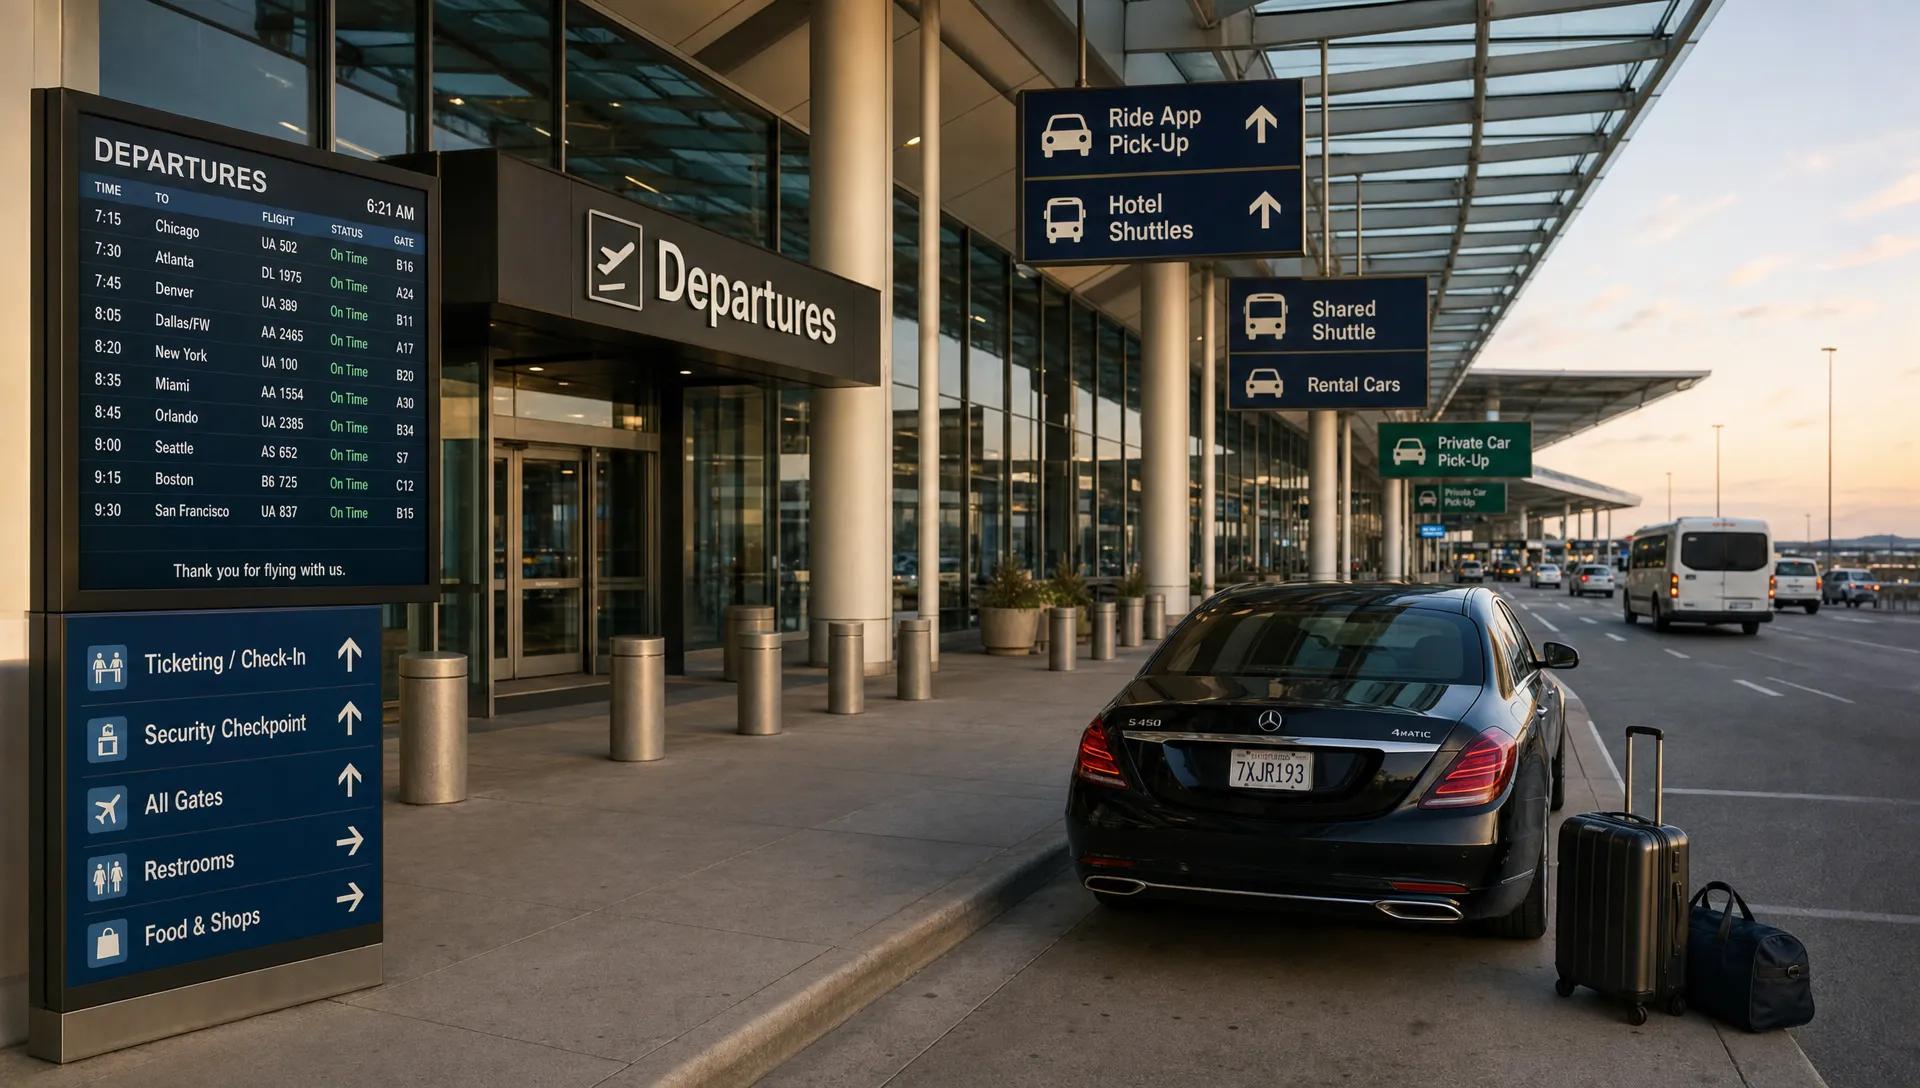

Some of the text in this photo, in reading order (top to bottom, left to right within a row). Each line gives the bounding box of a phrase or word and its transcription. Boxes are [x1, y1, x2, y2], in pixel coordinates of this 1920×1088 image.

[1110, 106, 1201, 129] Ride App
[1110, 133, 1188, 156] Pick-Up
[95, 137, 266, 193] DEPARTURES
[95, 182, 413, 247] TIME TO FLIGHT STATUS GATE
[367, 199, 414, 220] 6:21 AM
[1110, 193, 1161, 214] Hotel
[96, 209, 413, 272] 7:15 Chicago UA 502 On Time B16
[1110, 220, 1193, 241] Shuttles
[96, 242, 413, 299] 7:30 Atlanta DL 1975 On Time A24
[96, 274, 412, 326] 7:45 Denver UA 389 On Time B11
[657, 238, 837, 345] Departures
[1313, 300, 1375, 317] Shared
[95, 307, 413, 354] 8:05 Dallas/FW AA 2465 On Time A17
[1313, 323, 1375, 340] Shuttle
[95, 340, 413, 381] 8:20 New York UA 100 On Time B20
[95, 372, 413, 408] 8:35 Miami AA 1554 On Time A30
[1309, 377, 1400, 392] Rental Cars
[95, 405, 413, 436] 8:45 Orlando UA 2385 On Time B34
[95, 437, 408, 463] 9:00 Seattle AS 652 On Time S7
[1439, 436, 1511, 449] Private Car
[1439, 454, 1489, 470] Pick-Up
[95, 470, 413, 491] 9:15 Boston B6 725 On Time C12
[1445, 488, 1486, 496] Private Car
[95, 503, 413, 519] 9:30 San Francisco UA 837 On Time B15
[1445, 498, 1475, 507] Pick-Up
[174, 563, 345, 580] Thank you for flying with us.
[145, 647, 305, 674] Ticketing / Check-In
[145, 714, 306, 744] Security Checkpoint
[1392, 729, 1430, 738] 4MATIC
[1236, 761, 1304, 784] 7XJR193
[145, 790, 222, 814] All Gates
[145, 854, 234, 881] Restrooms
[146, 910, 260, 946] Food & Shops
